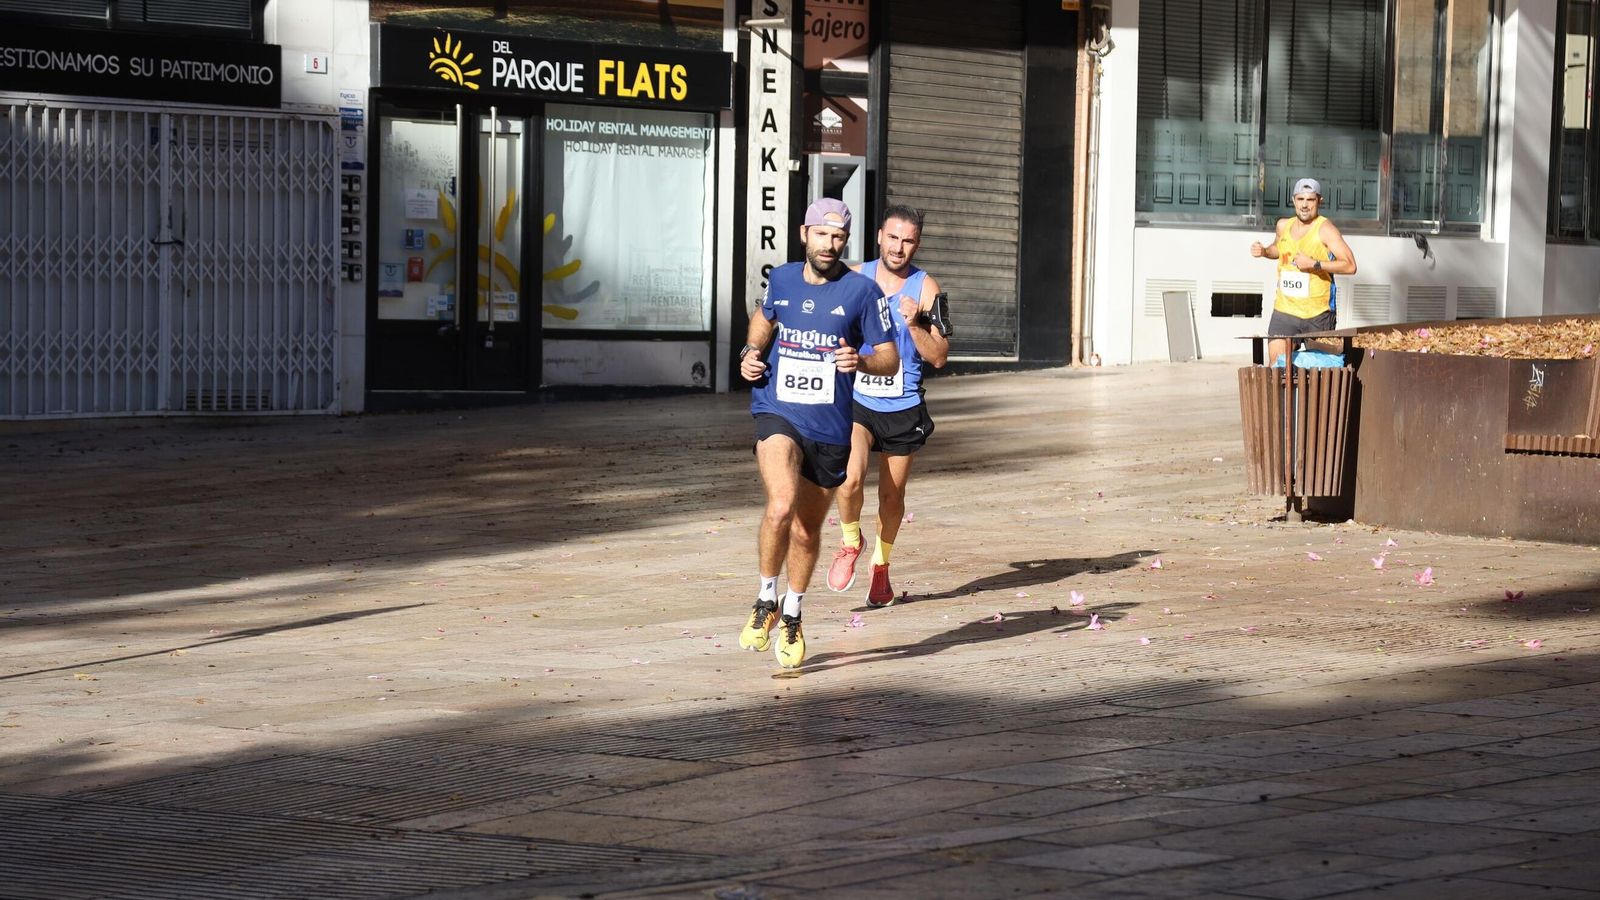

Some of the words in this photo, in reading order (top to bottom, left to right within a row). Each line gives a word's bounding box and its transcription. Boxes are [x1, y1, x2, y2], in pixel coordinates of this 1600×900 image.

[492, 40, 513, 54] DEL
[313, 57, 319, 69] 6
[129, 57, 154, 77] SU
[160, 59, 274, 86] PATRIMONIO
[492, 56, 585, 93] PARQUE
[598, 59, 688, 101] FLATS
[546, 118, 596, 134] HOLIDAY
[598, 121, 637, 136] RENTAL
[640, 124, 713, 140] MANAGEMENT
[564, 141, 614, 155] HOLIDAY
[617, 143, 655, 157] RENTAL
[1283, 280, 1303, 289] 950
[778, 322, 838, 349] Prague
[787, 348, 821, 360] Marathon
[785, 374, 824, 391] 820
[860, 374, 895, 387] 448
